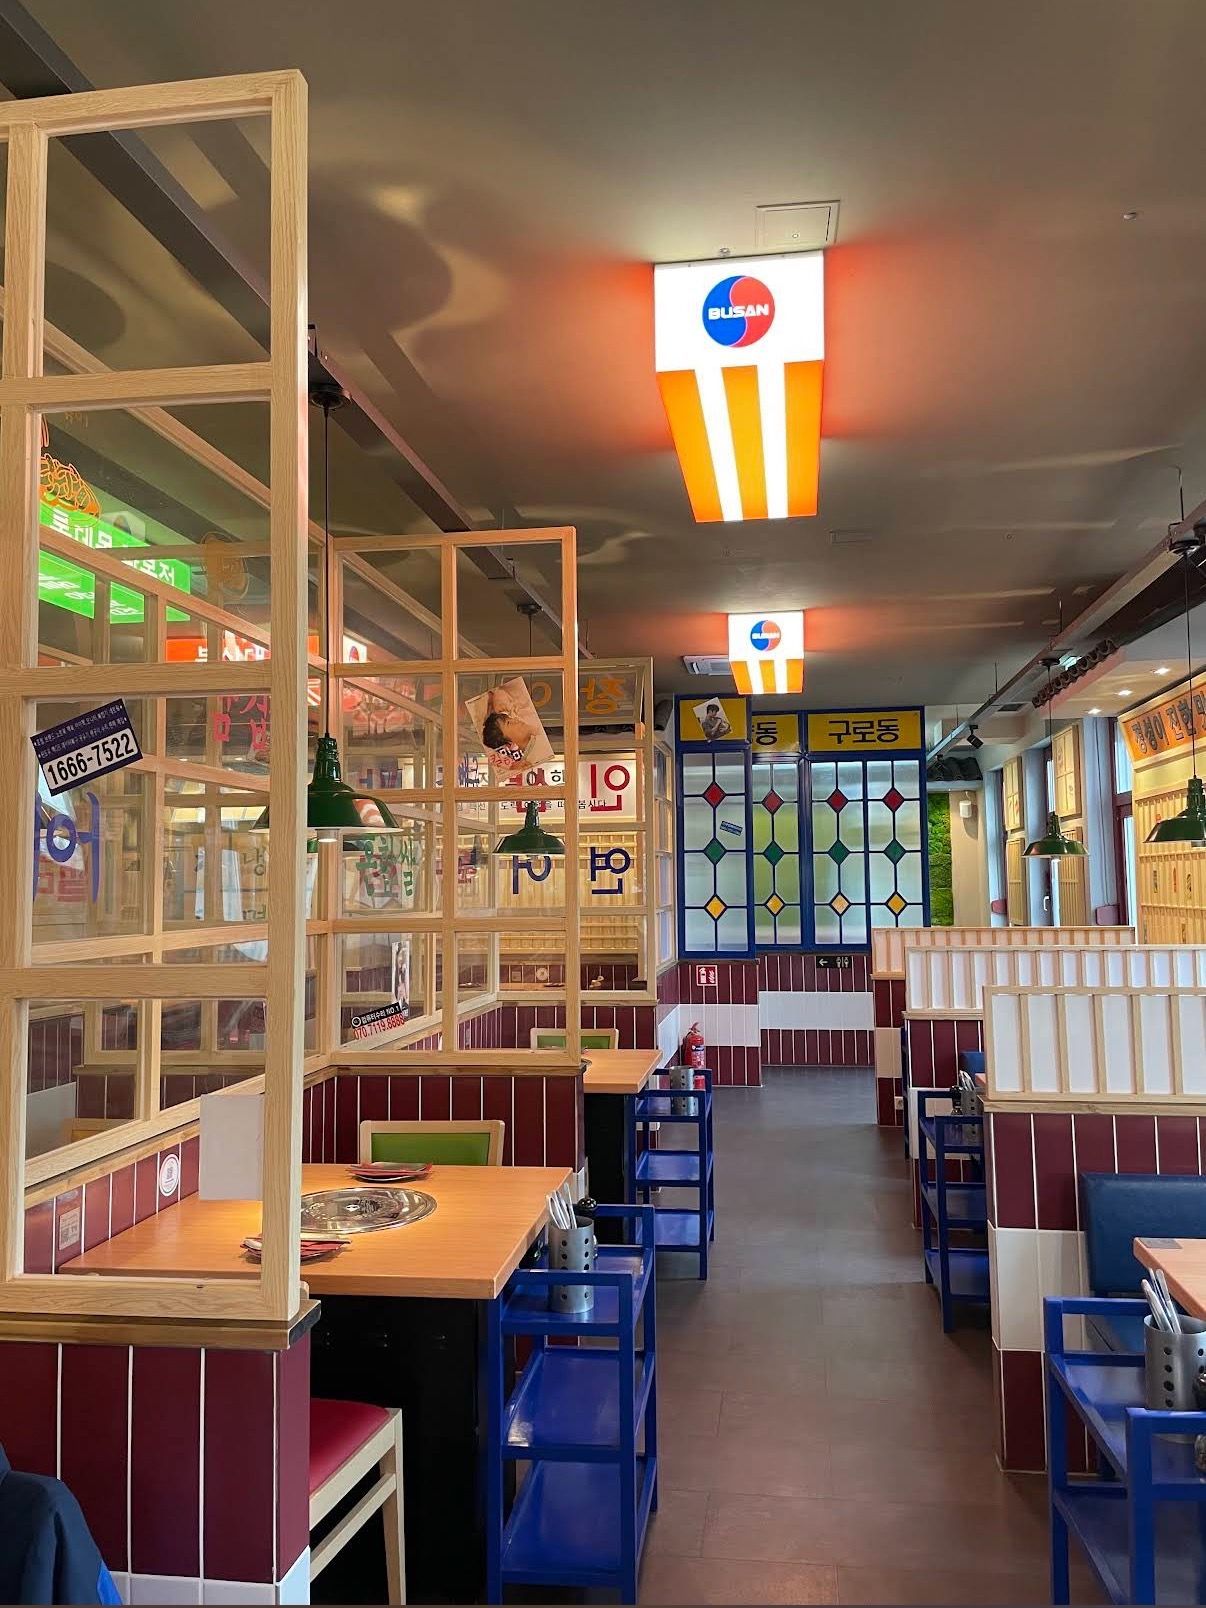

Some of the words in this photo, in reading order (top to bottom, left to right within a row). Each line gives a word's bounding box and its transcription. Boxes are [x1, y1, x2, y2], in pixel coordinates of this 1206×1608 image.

[707, 303, 770, 320] BUSAN
[752, 721, 778, 746] 동
[828, 717, 900, 745] 구로동
[1131, 711, 1170, 754] 정성이
[47, 732, 134, 786] 1666-7522
